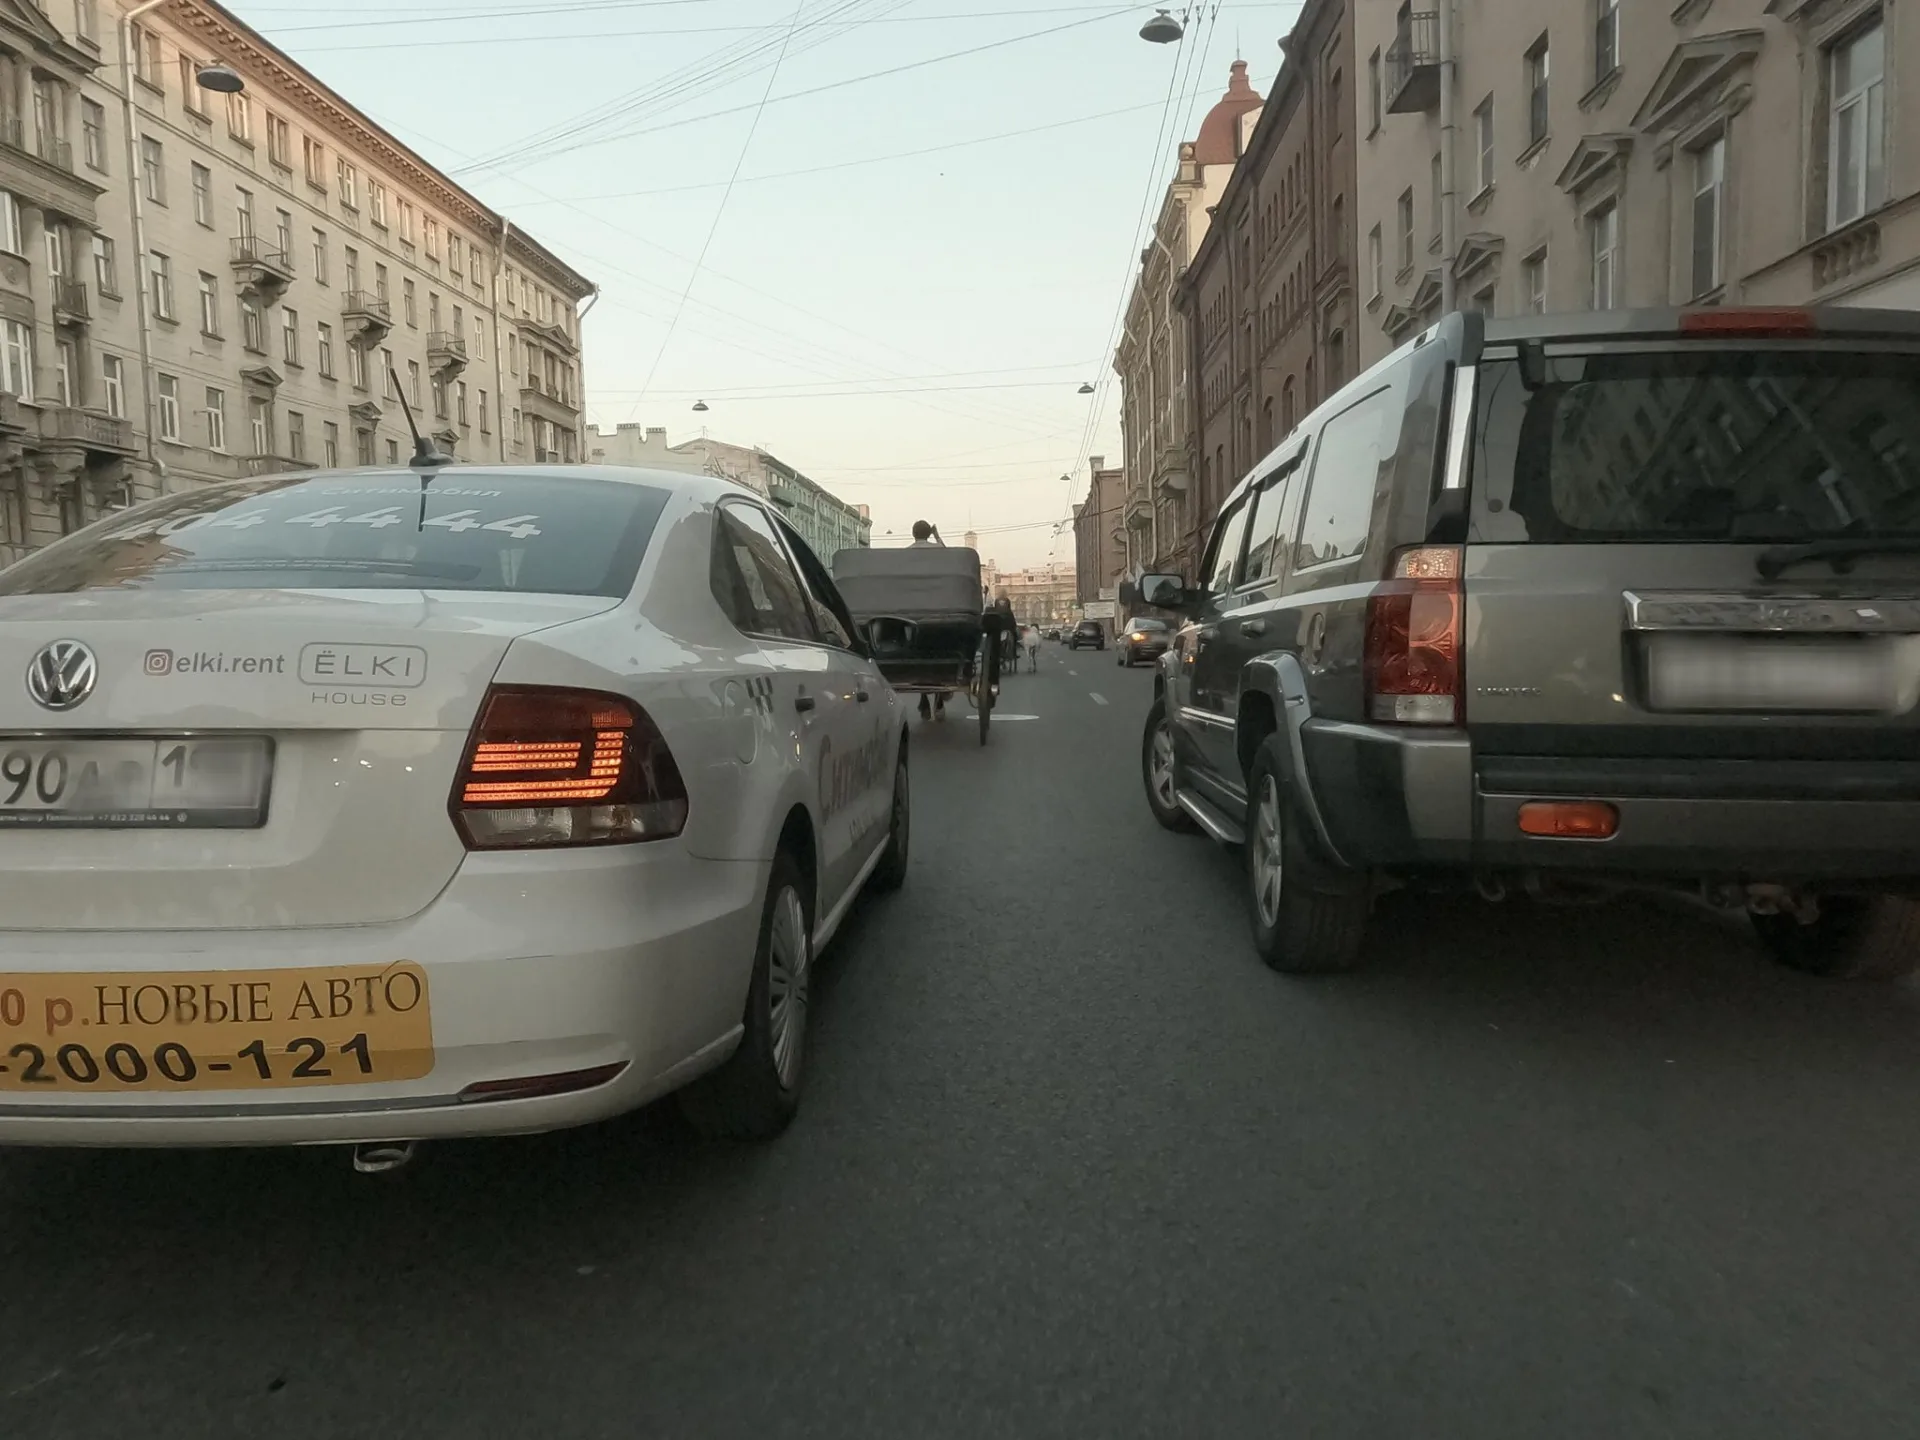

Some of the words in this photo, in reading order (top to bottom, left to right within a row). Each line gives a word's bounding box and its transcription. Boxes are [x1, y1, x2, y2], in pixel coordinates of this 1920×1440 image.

[284, 506, 404, 528] 44
[421, 509, 542, 539] 44
[176, 652, 285, 674] elki.rent
[314, 650, 411, 677] ËLKI
[287, 971, 421, 1022] АВТО
